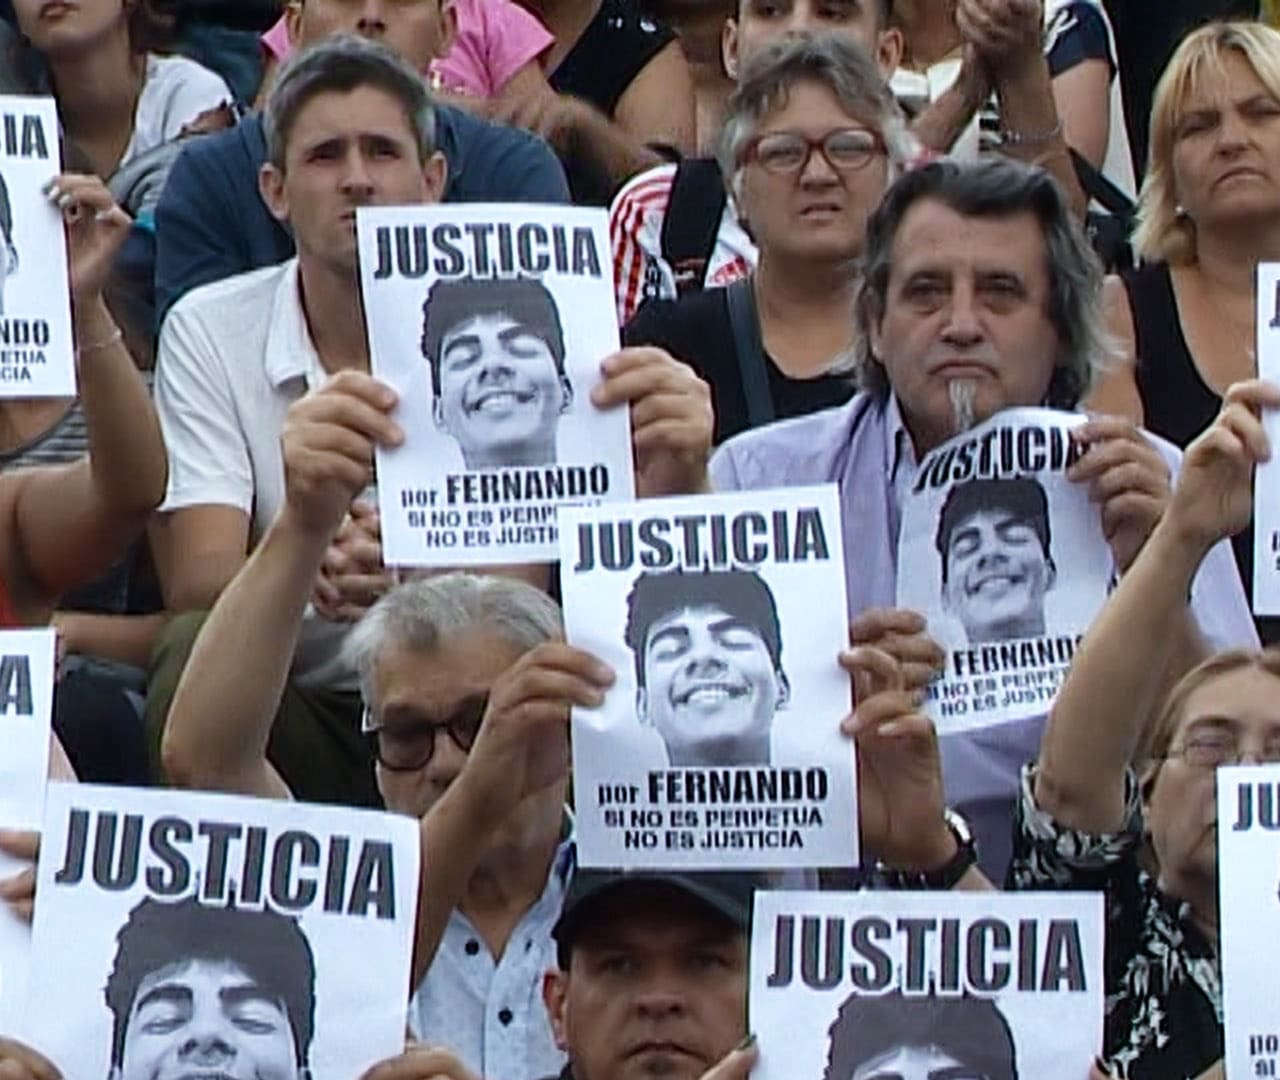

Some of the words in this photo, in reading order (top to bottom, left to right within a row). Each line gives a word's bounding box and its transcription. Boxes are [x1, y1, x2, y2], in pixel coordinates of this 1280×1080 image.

[374, 222, 602, 280] JUSTICIA
[401, 489, 439, 508] por
[446, 463, 610, 504] FERNANDO
[431, 510, 461, 527] NO
[467, 509, 493, 526] ES
[499, 505, 559, 525] PERP
[427, 530, 457, 547] NO
[464, 528, 491, 547] ES
[496, 526, 559, 545] JUSTI
[574, 507, 830, 573] JUSTICIA
[953, 635, 1082, 677] FERNAND
[940, 700, 968, 716] NO
[1001, 686, 1056, 707] JUSTI
[942, 682, 969, 700] NO
[1001, 669, 1060, 690] PERPE
[598, 784, 638, 806] por
[648, 767, 829, 804] FERNANDO
[604, 809, 624, 827] SI
[631, 809, 663, 827] NO
[670, 809, 698, 827] ES
[705, 806, 823, 827] PERPETUA
[625, 830, 657, 849] NO
[665, 830, 694, 850] ES
[701, 830, 804, 849] JUSTICIA
[55, 808, 396, 922] JUSTICIA
[767, 913, 1088, 993] JUSTICIA
[1254, 1058, 1275, 1076] SI
